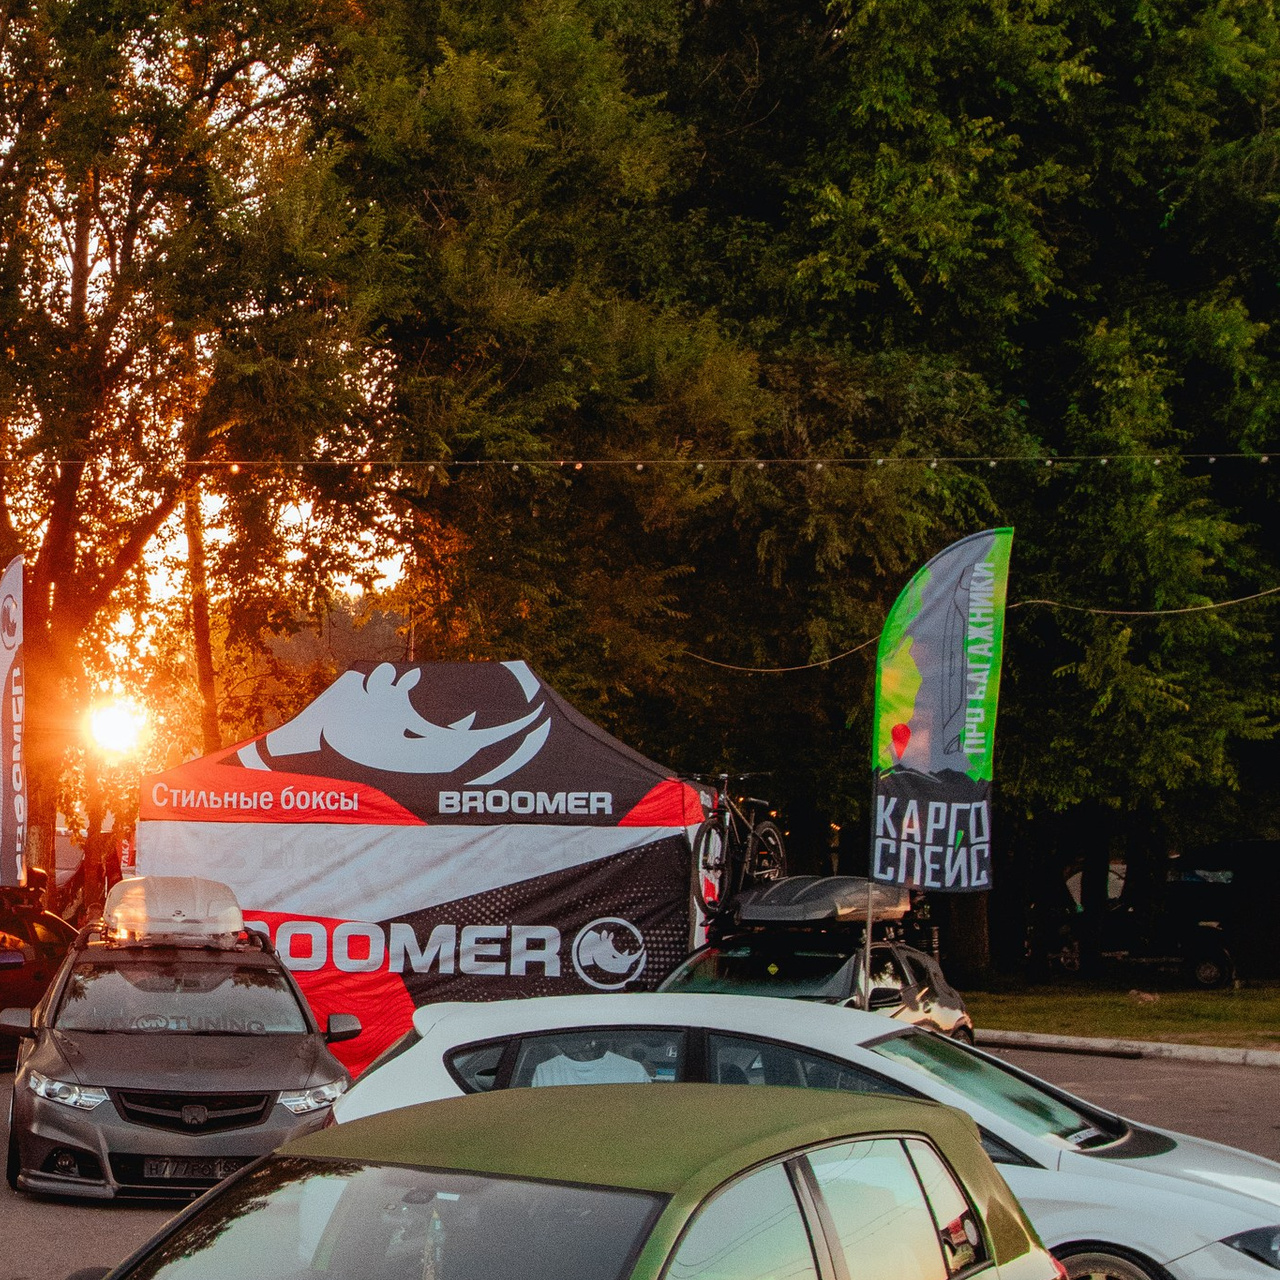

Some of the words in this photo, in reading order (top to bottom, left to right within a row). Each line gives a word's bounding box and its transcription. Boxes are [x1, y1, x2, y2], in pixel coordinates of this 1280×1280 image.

[966, 562, 995, 700] БАГАЖНИКИ
[152, 782, 274, 810] Стильные
[280, 786, 359, 811] боксы
[438, 789, 613, 815] BROOMER
[876, 795, 990, 846] КАРГО
